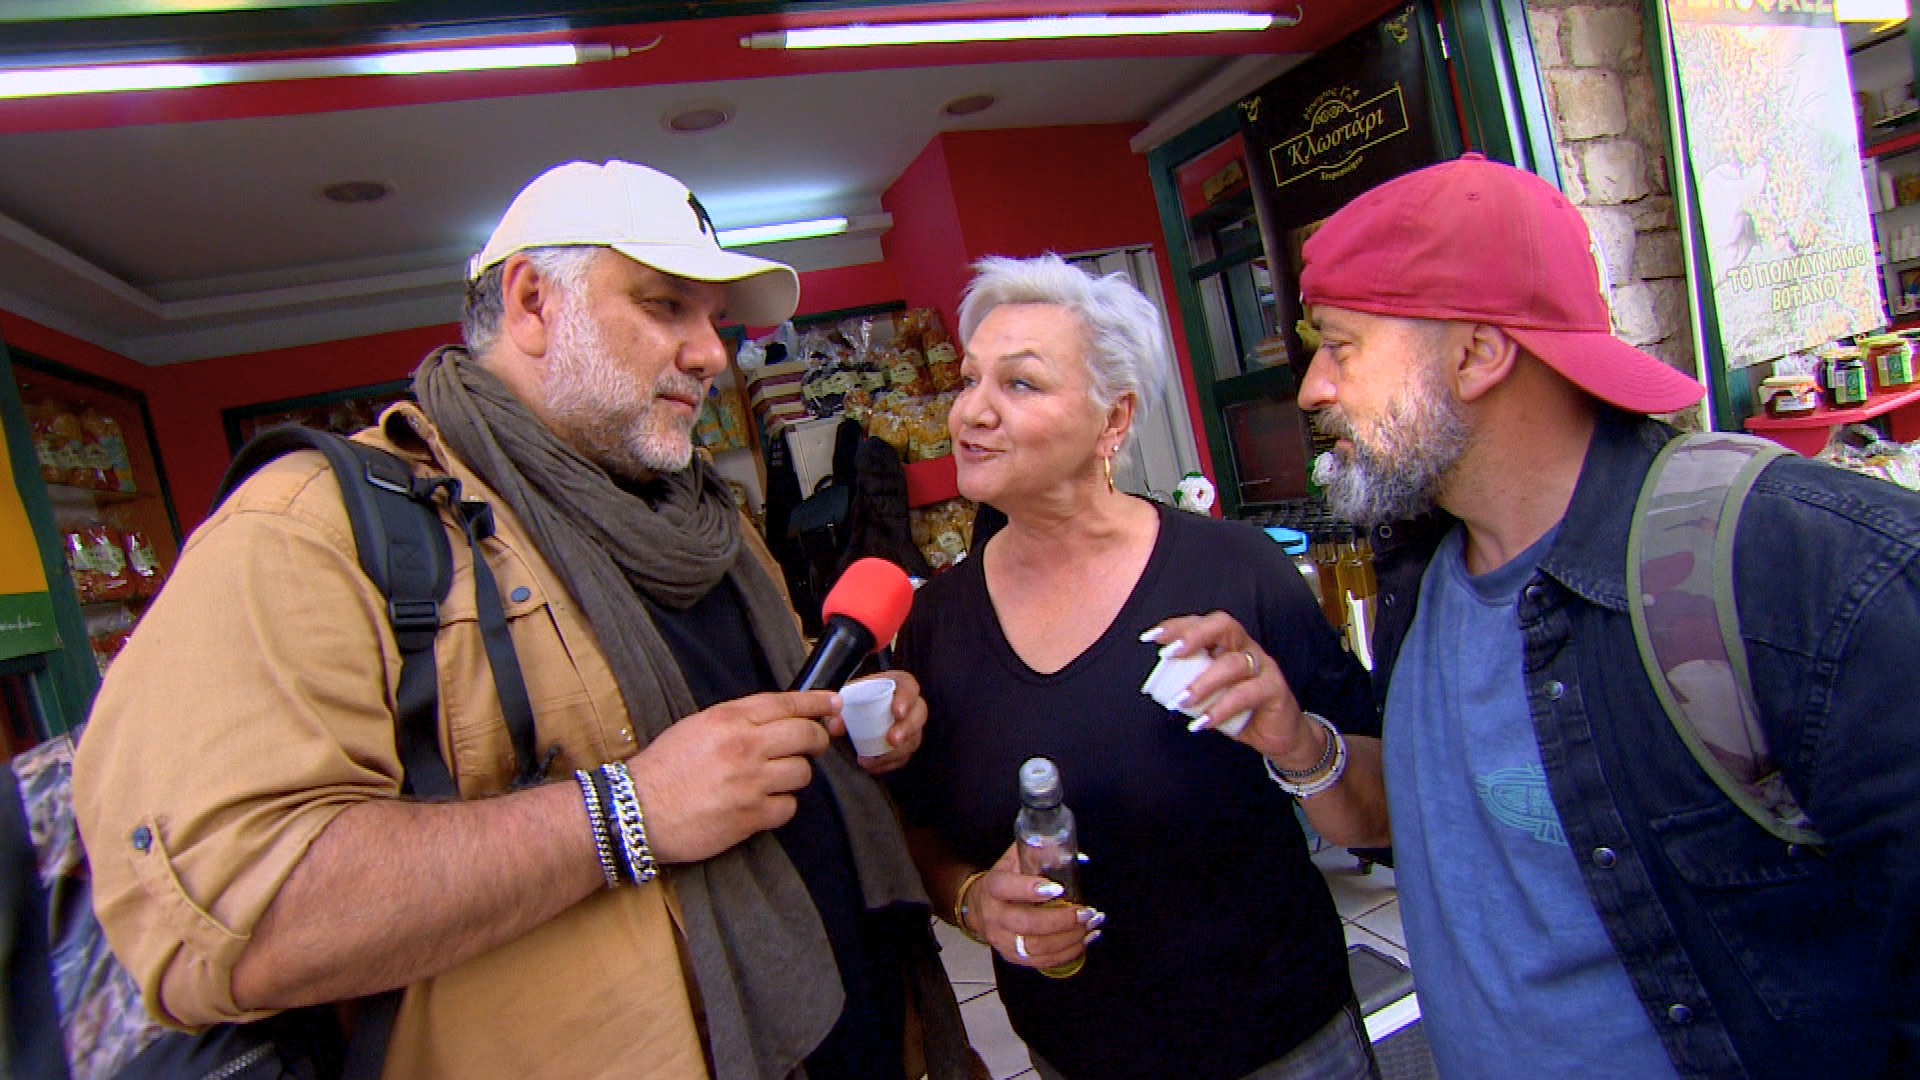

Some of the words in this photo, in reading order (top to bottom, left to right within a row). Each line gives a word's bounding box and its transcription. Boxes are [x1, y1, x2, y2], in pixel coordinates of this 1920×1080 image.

[1288, 108, 1384, 166] Κλωστάρι
[1727, 266, 1754, 294] ΤΟ
[1755, 244, 1867, 288] ΠΟΛΥΔΥΝΑΜΟ
[1771, 277, 1837, 312] ΒΟΤΑΝΟ
